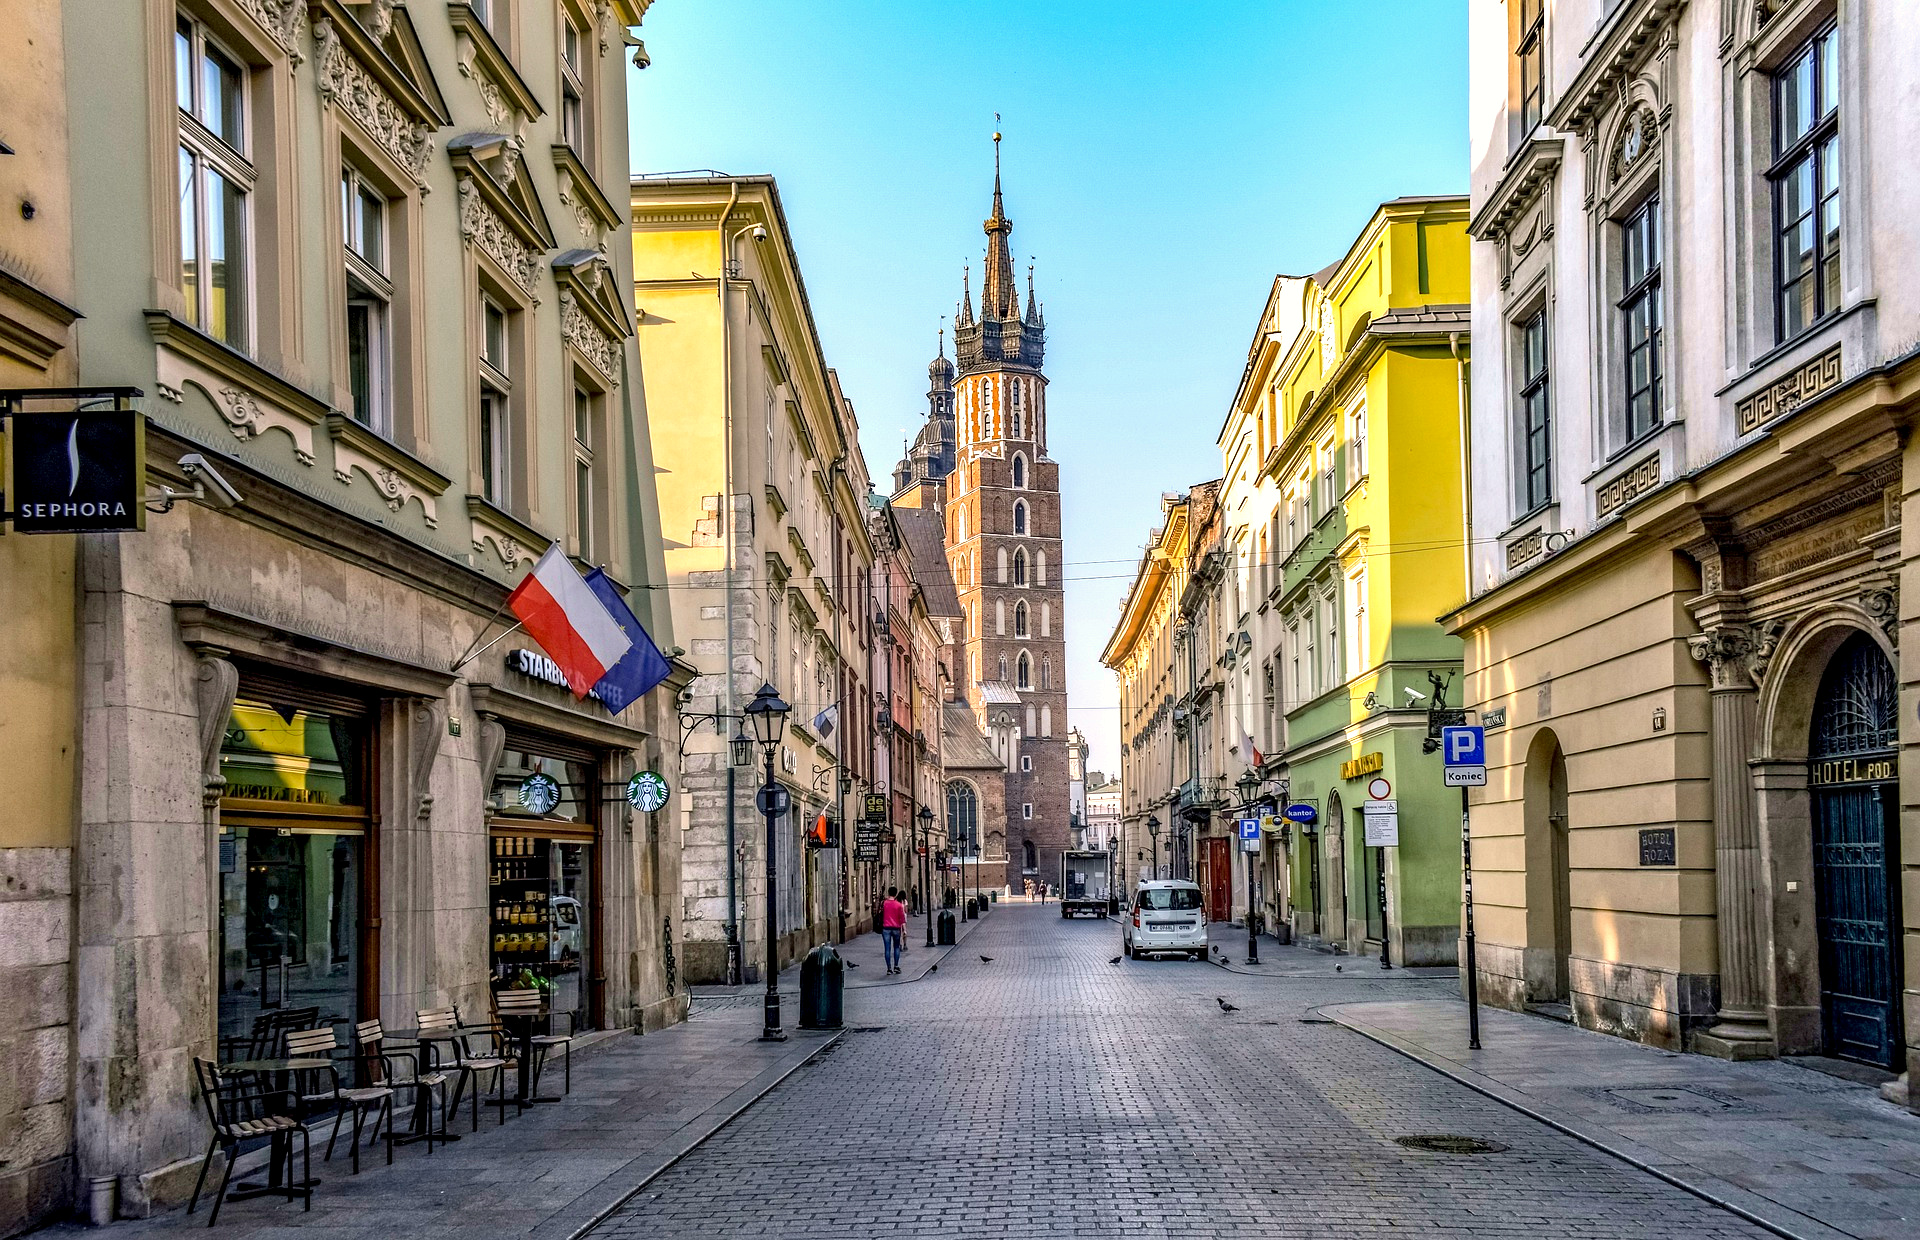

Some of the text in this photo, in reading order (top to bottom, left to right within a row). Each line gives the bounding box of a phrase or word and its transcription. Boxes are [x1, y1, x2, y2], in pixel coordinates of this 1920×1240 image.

[21, 502, 127, 518] SEPHORA
[737, 747, 745, 757] 17
[1451, 730, 1476, 762] P
[1448, 771, 1482, 781] Koniec
[1812, 760, 1890, 784] HOTEL POD
[1243, 821, 1256, 837] P
[1642, 833, 1672, 847] HOTEL
